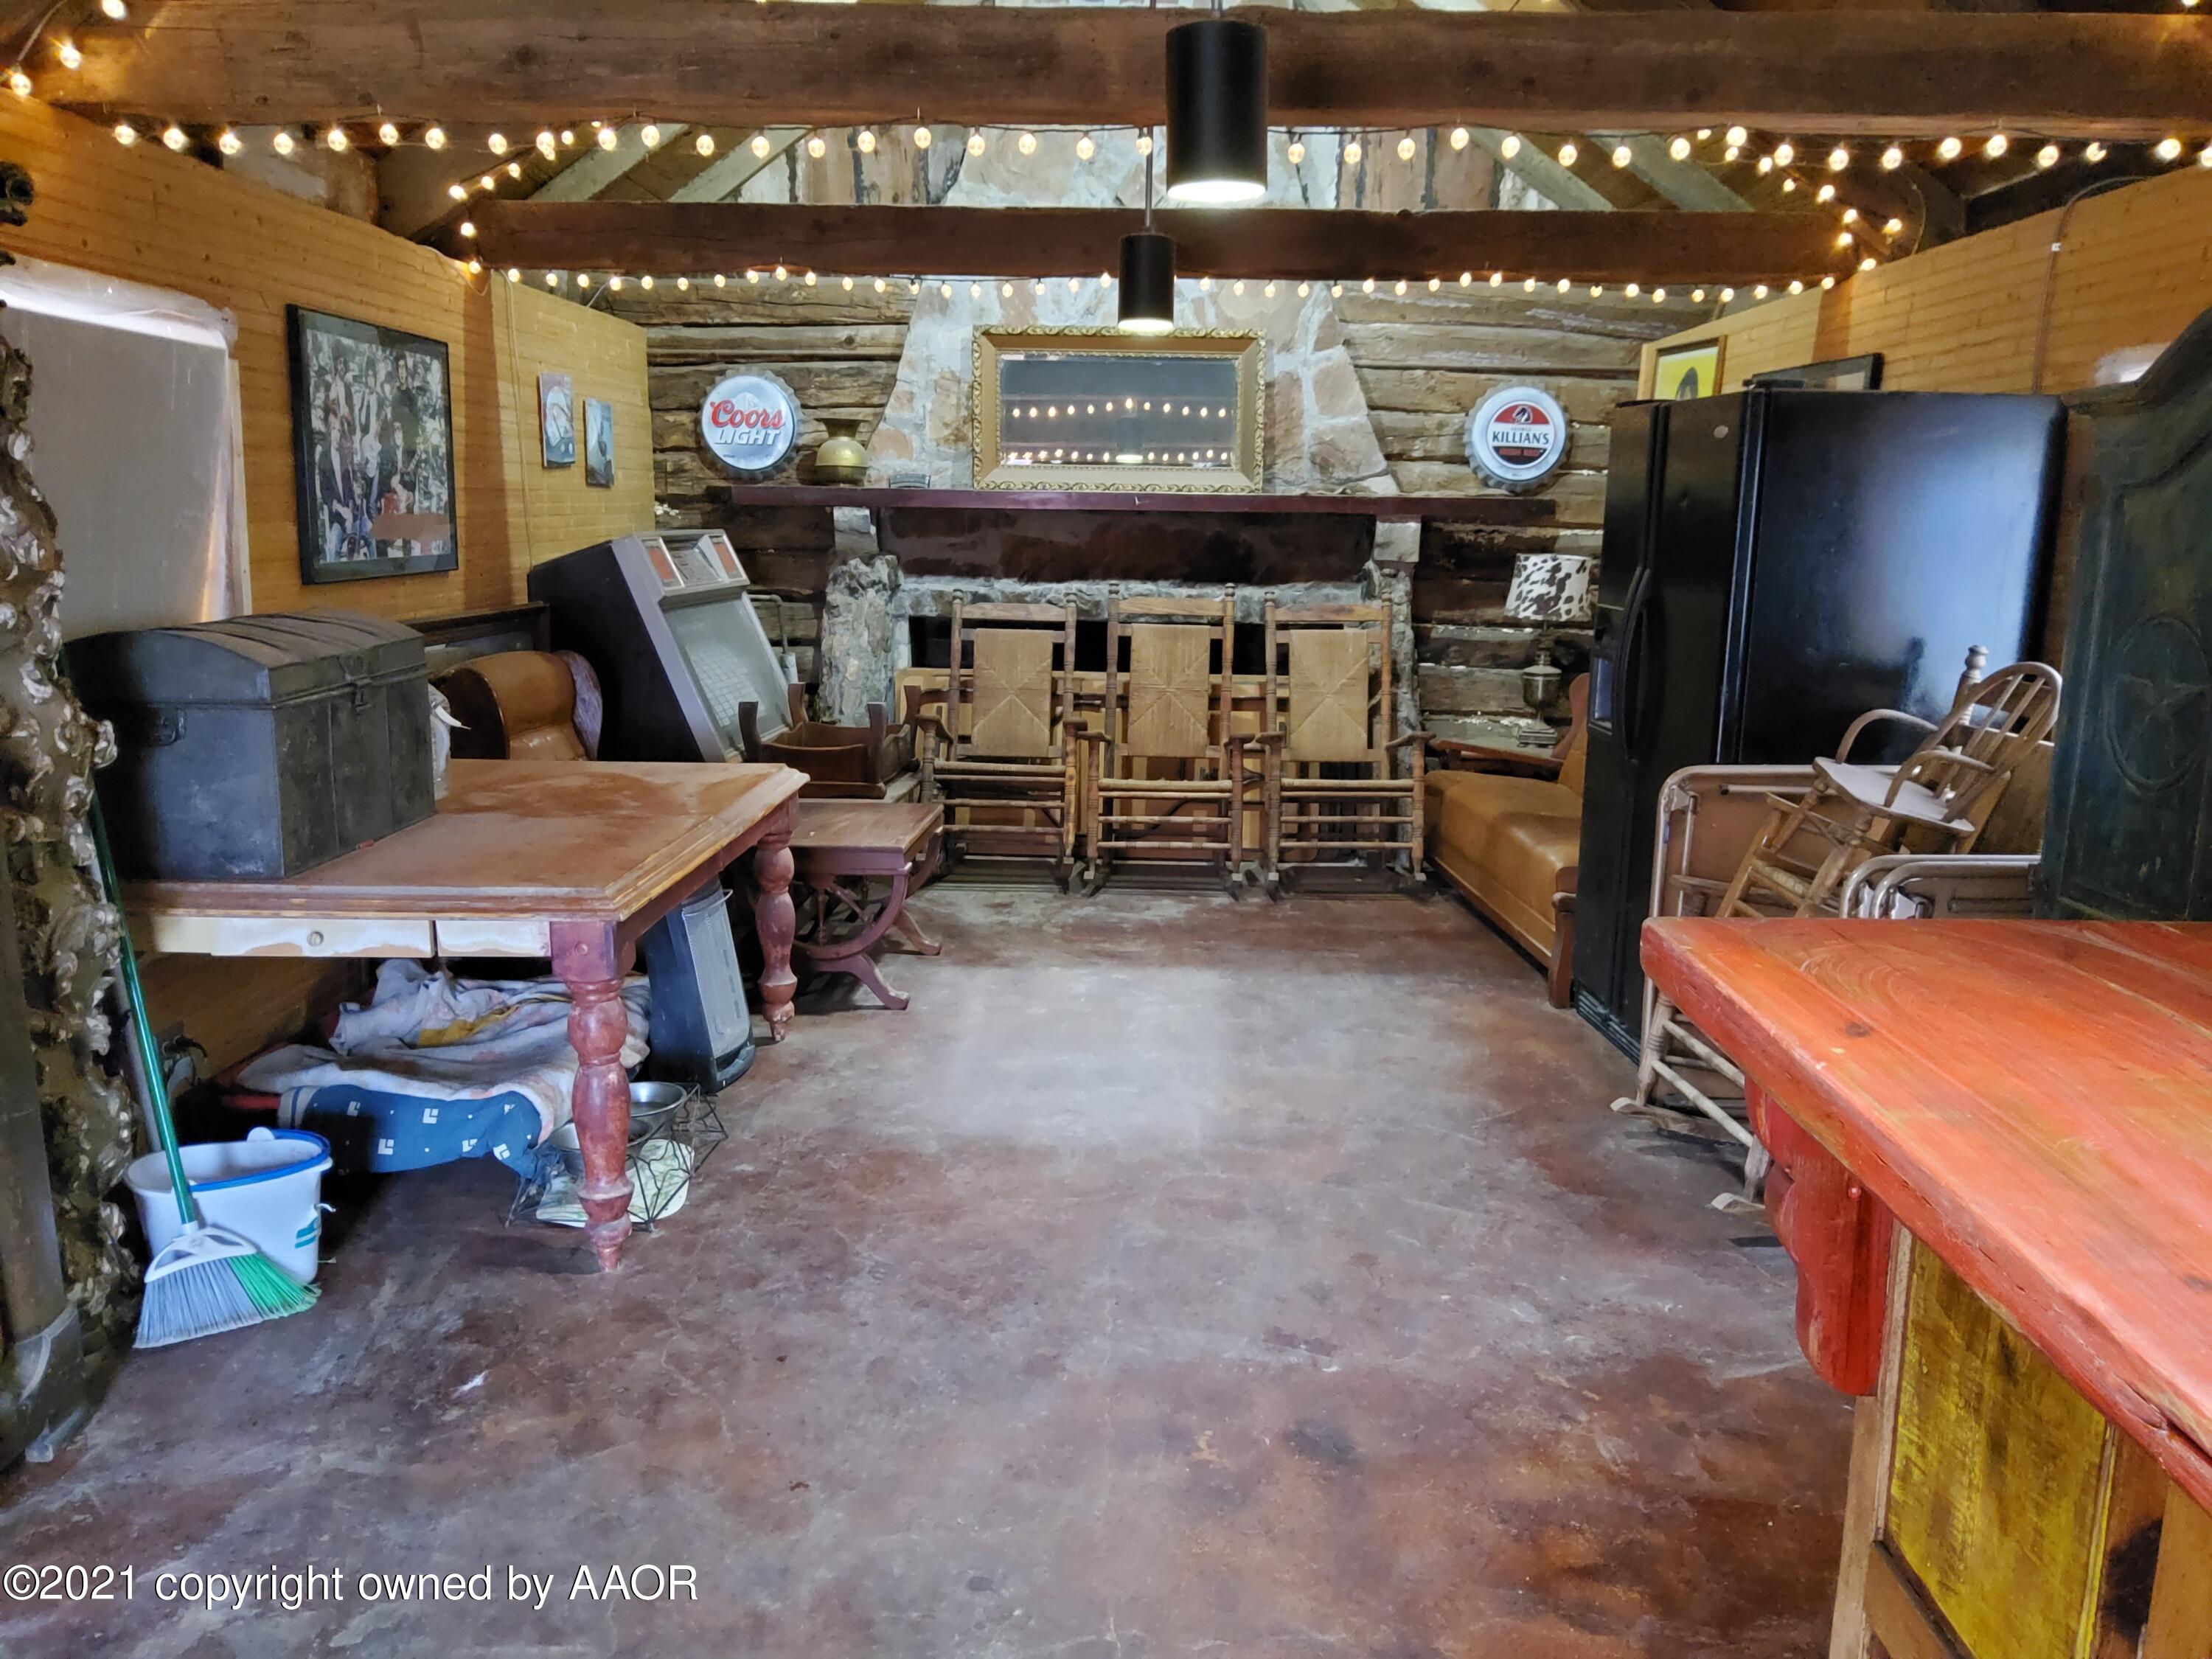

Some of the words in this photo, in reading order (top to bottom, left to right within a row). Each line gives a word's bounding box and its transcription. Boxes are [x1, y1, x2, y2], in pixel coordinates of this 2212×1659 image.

[710, 399, 785, 429] Coors
[714, 429, 781, 446] LIGHT
[1492, 431, 1549, 445] KILLIAN'S
